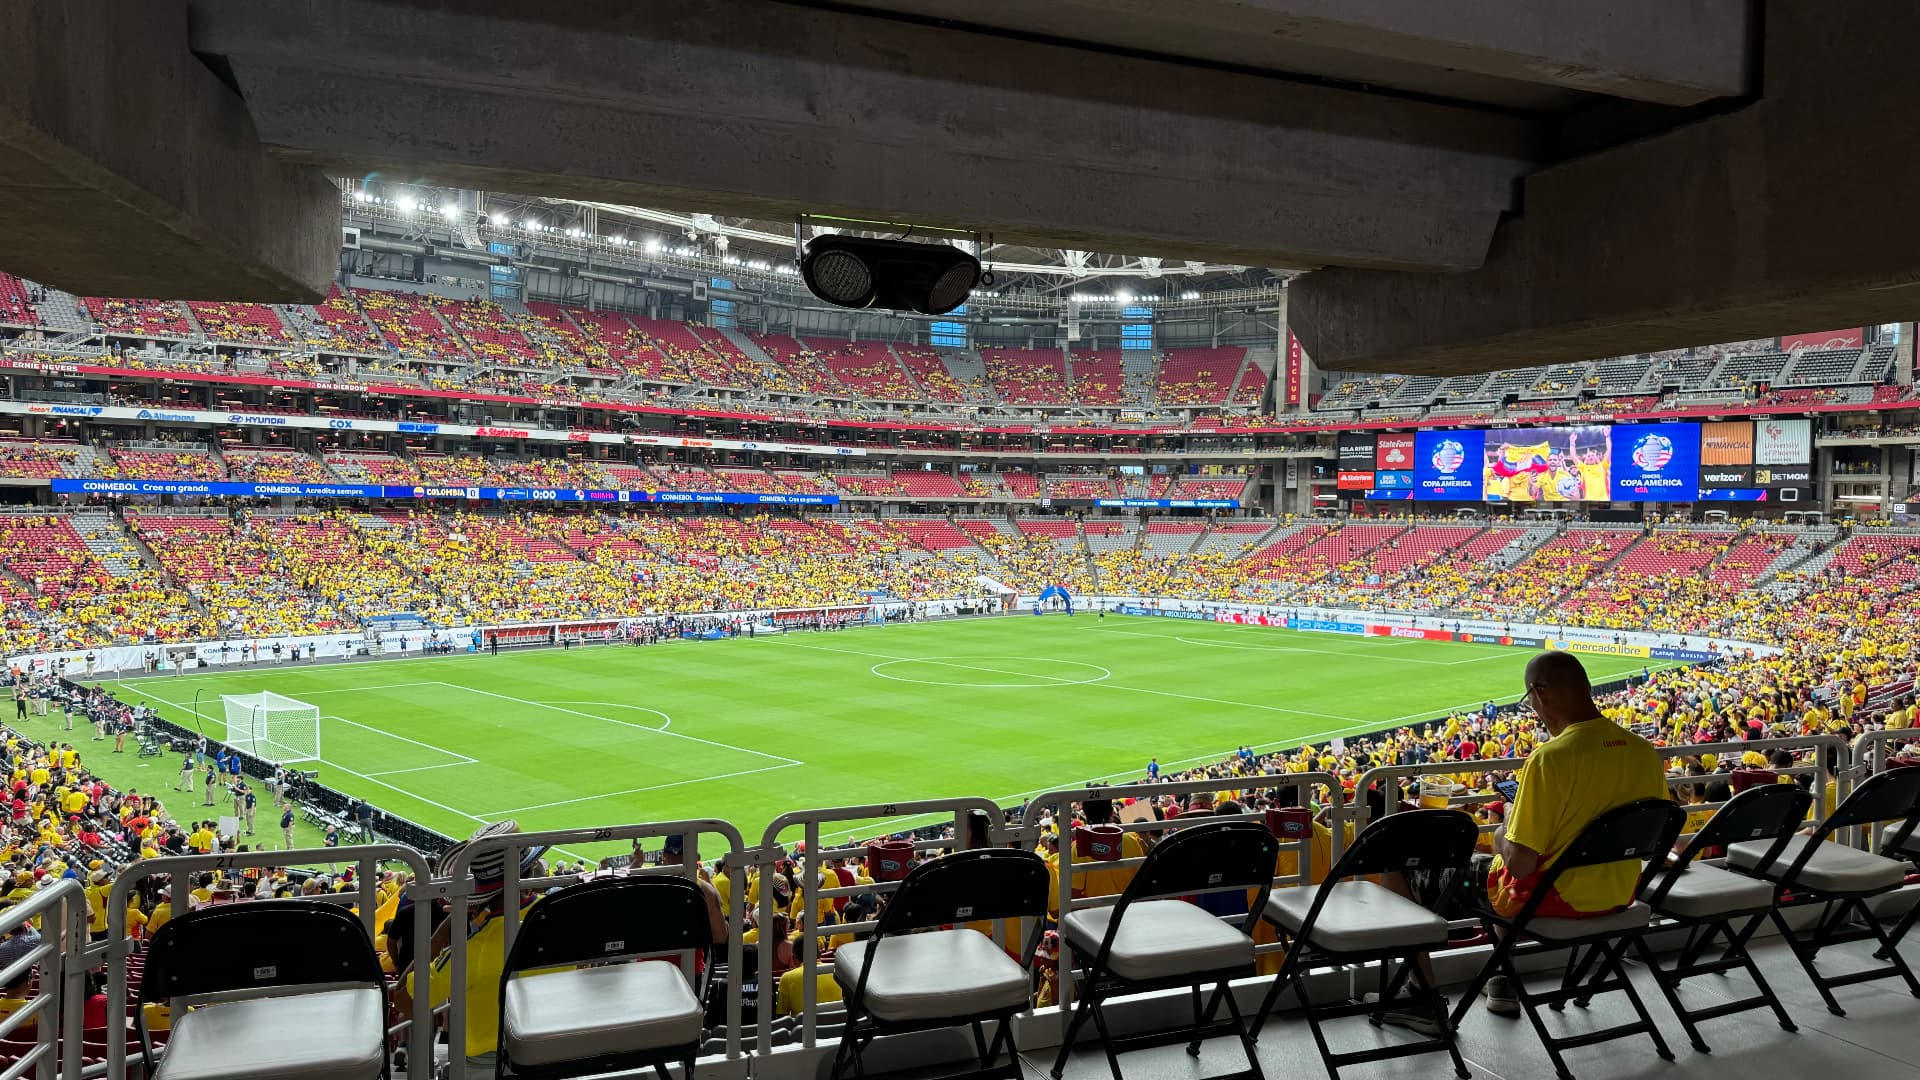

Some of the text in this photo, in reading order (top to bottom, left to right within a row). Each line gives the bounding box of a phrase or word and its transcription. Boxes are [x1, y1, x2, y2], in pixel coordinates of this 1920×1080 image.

[12, 361, 39, 369] ERNIE
[41, 363, 78, 372] NEVERS
[51, 406, 88, 415] FINANCIAL
[153, 412, 196, 422] Albertsons
[245, 416, 286, 425] HYUNDAI
[329, 419, 353, 428] COX
[489, 427, 529, 438] State Farm
[1707, 440, 1750, 449] FINANCIAL
[1703, 472, 1742, 482] verizon
[1771, 473, 1808, 481] BETMGM
[82, 482, 139, 491] CONMEBOL
[1620, 479, 1683, 487] COPA AMERICA
[254, 485, 303, 494] CONMEBOL
[426, 487, 466, 497] COLOMBIA
[1164, 609, 1188, 618] ABSOLUT
[1216, 613, 1236, 623] TCL
[1241, 615, 1261, 625] TCL
[1265, 617, 1288, 626] TCL
[1339, 624, 1365, 633] BYD
[1390, 626, 1425, 639] Betano
[1572, 642, 1641, 656] mercado libre
[1088, 789, 1101, 799] 24
[882, 804, 897, 815] 25
